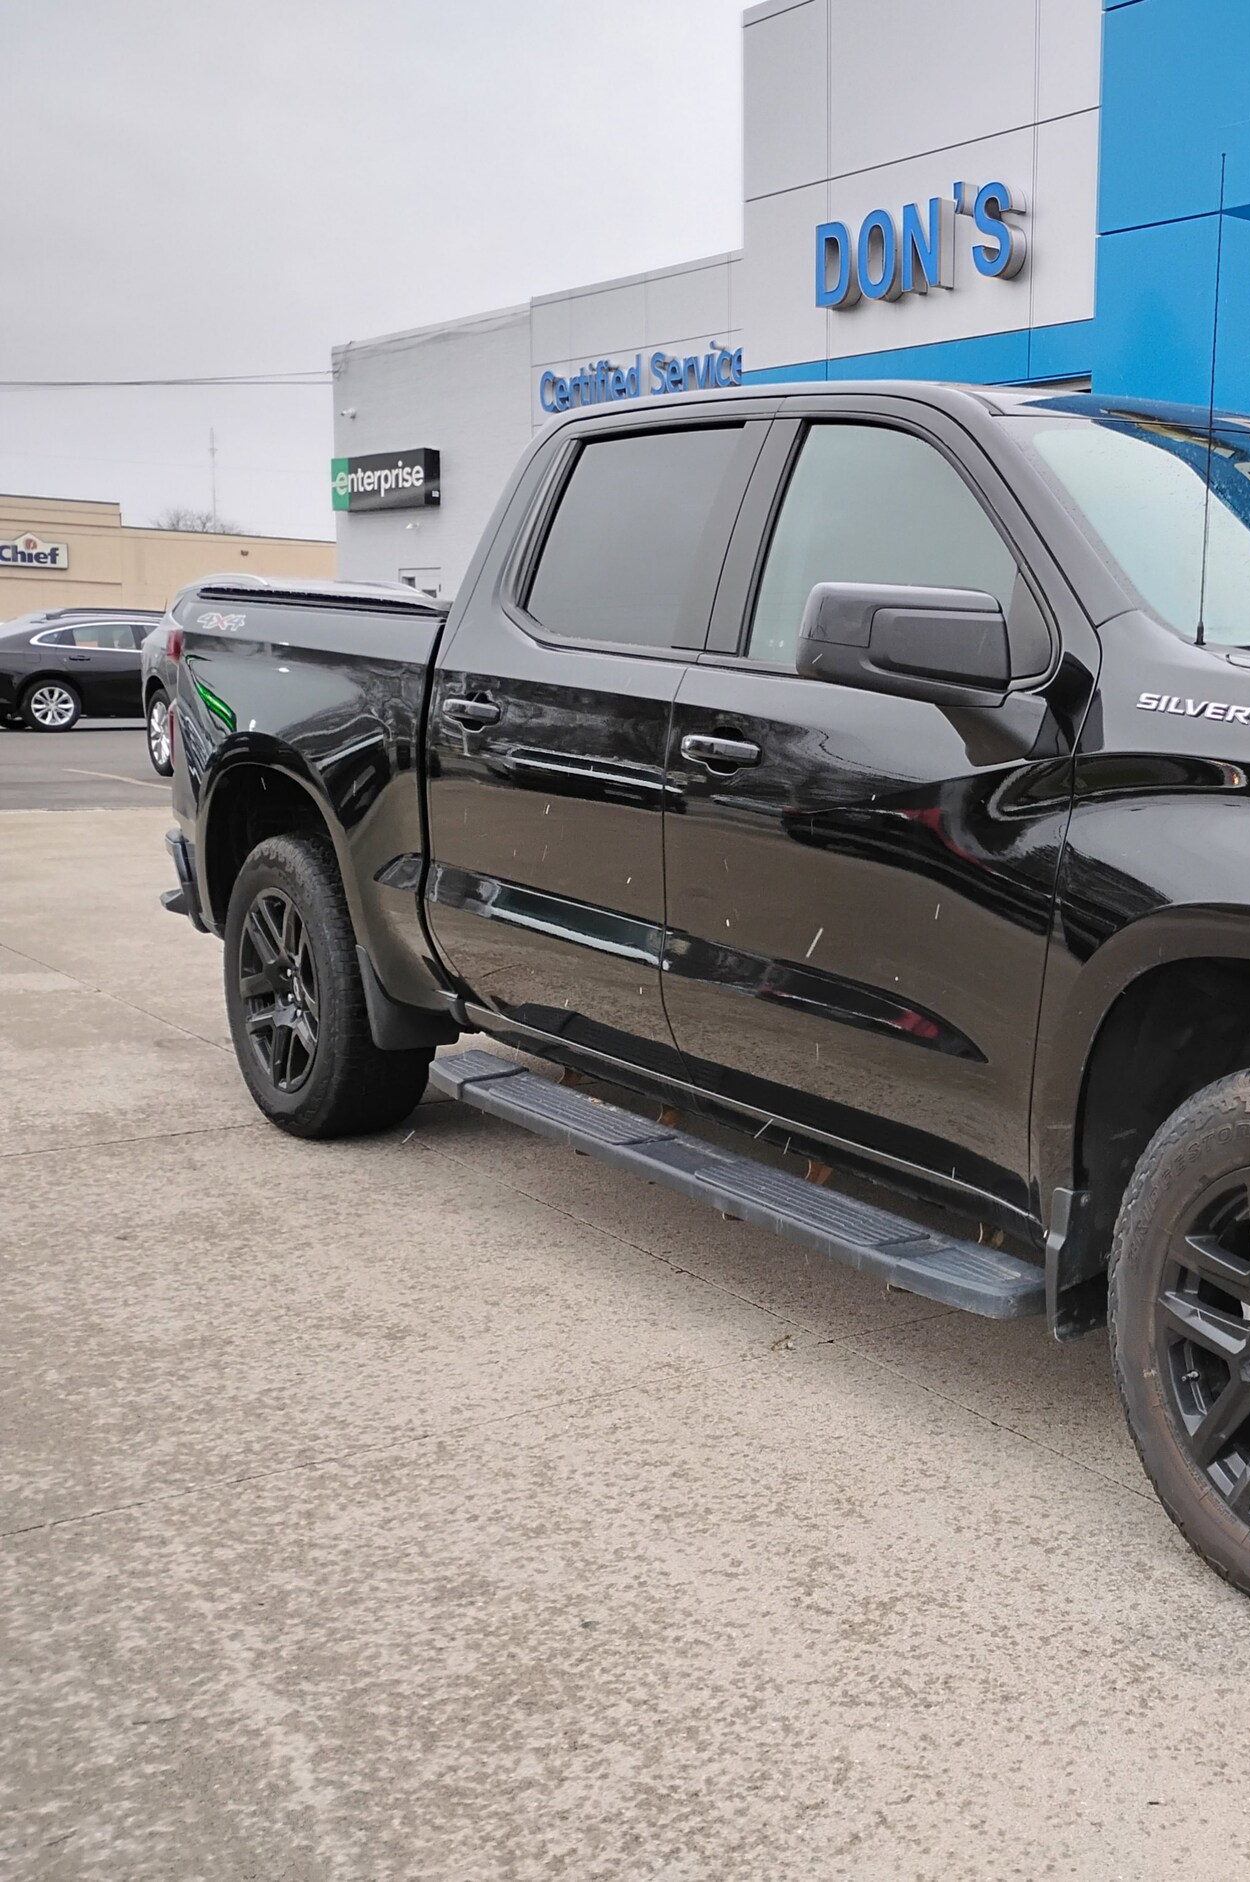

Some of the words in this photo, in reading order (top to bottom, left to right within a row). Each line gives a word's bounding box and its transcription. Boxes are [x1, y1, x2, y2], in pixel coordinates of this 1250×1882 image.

[815, 180, 1026, 308] DON'S
[540, 355, 641, 414] Certified
[650, 339, 743, 396] Service
[331, 460, 425, 498] enterprise
[0, 544, 59, 565] Chief
